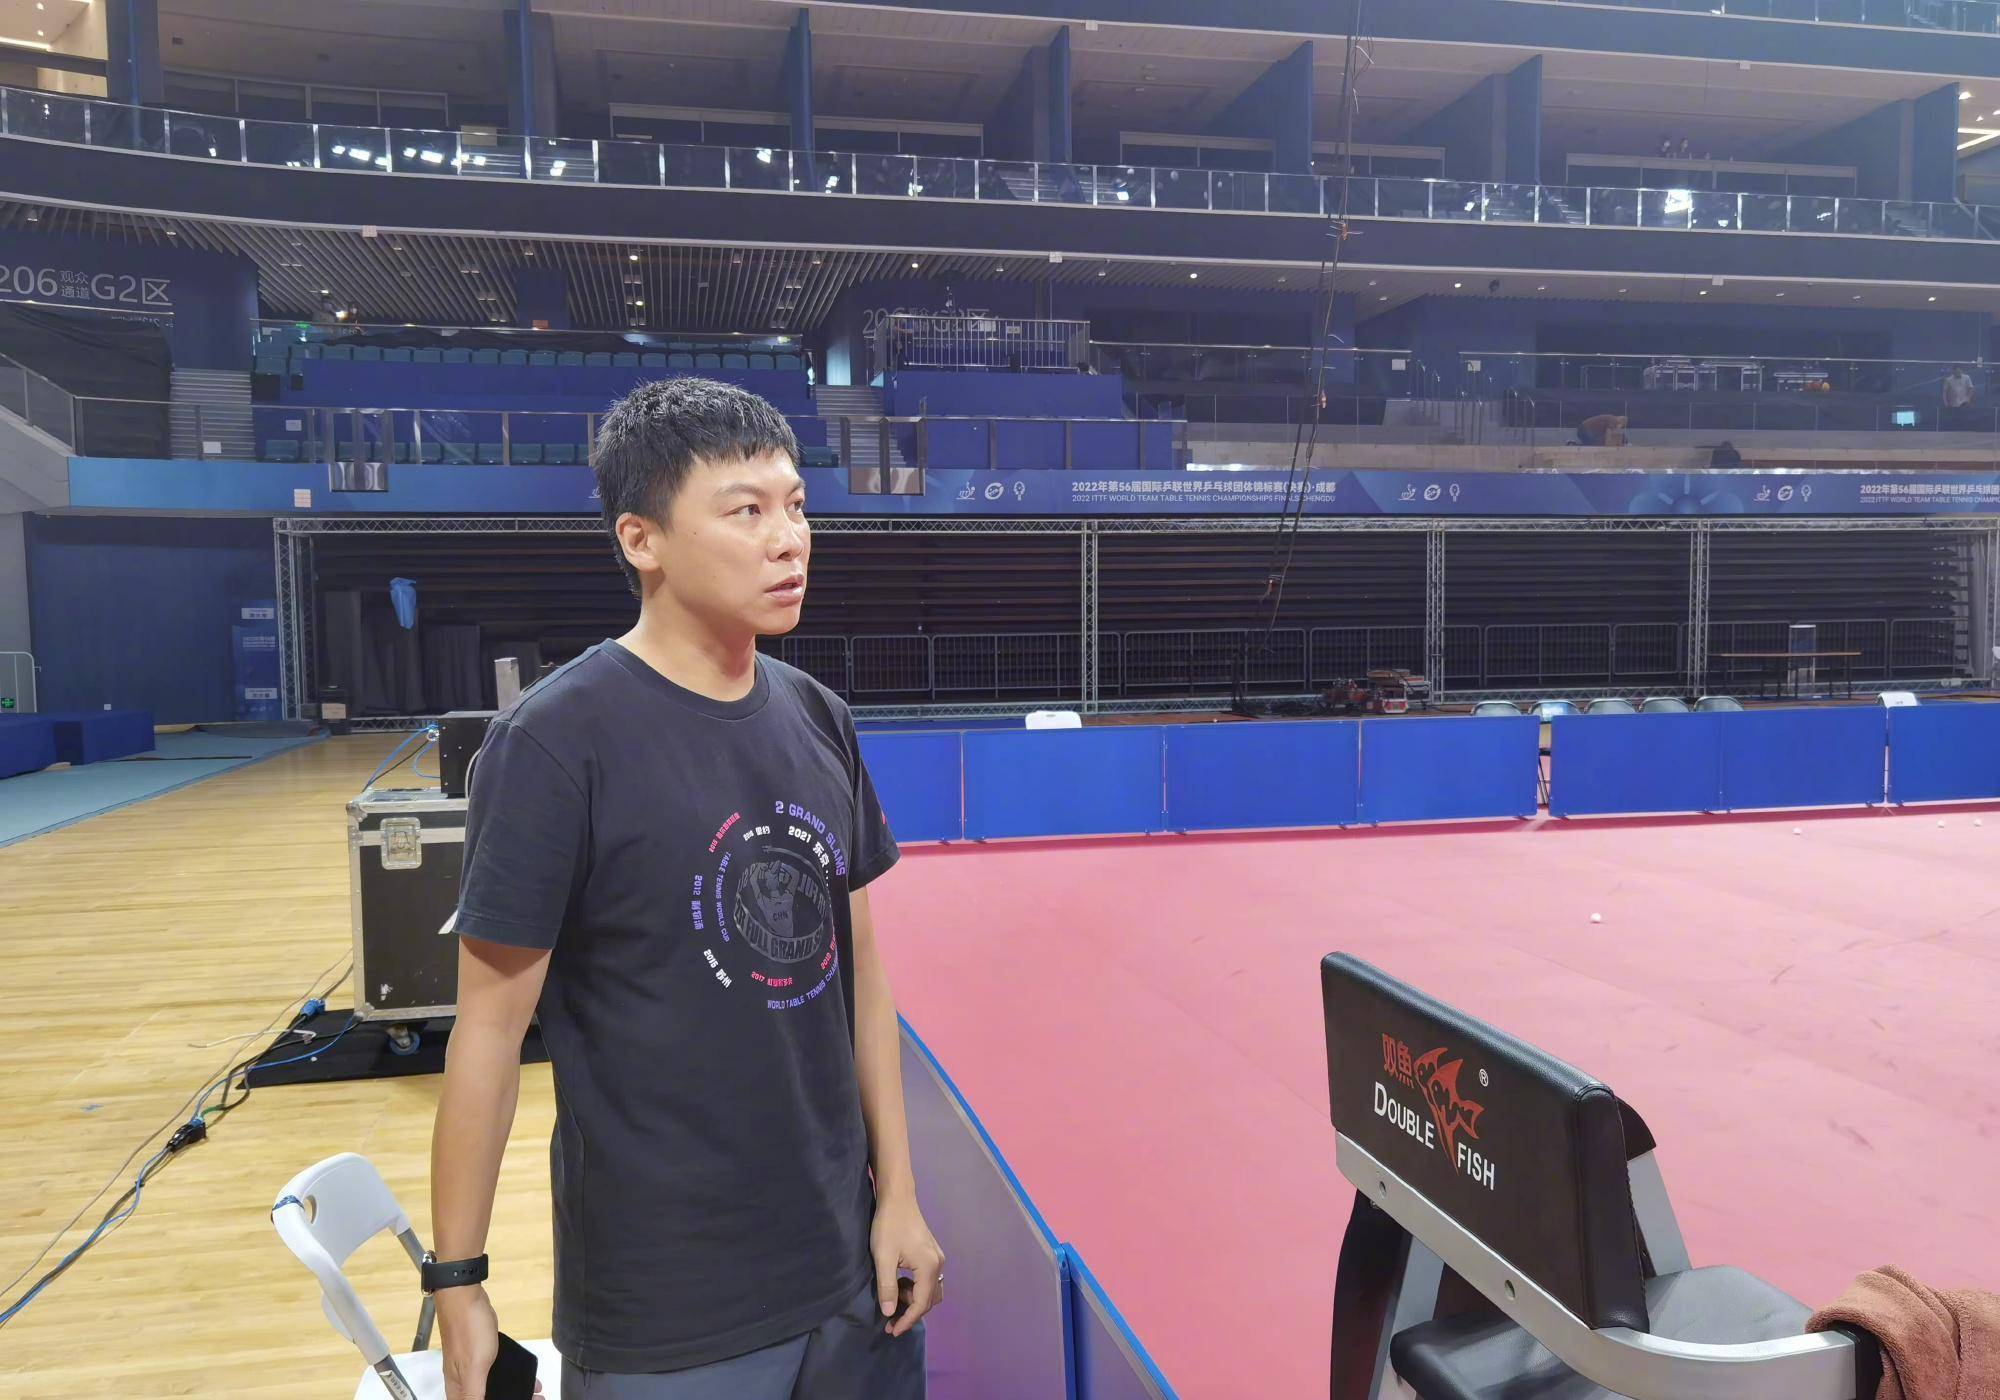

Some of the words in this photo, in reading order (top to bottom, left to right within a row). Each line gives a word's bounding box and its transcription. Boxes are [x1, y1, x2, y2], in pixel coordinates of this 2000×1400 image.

[0, 265, 58, 296] 206
[60, 271, 89, 285] 观众
[91, 273, 173, 306] G2区
[61, 286, 90, 299] 通道
[1072, 494, 1090, 502] 2022
[1092, 494, 1107, 502] ITTF
[1109, 494, 1135, 502] WORLD
[1138, 494, 1158, 502] TEAM
[1160, 494, 1183, 502] TABLE
[1185, 494, 1211, 502] TENNIS
[1213, 494, 1273, 502] CHAMPIONSHIPS
[775, 801, 784, 814] 2
[789, 803, 826, 834] GRAND
[825, 833, 846, 876] SLAMS
[788, 826, 811, 843] 2021
[719, 851, 732, 873] TABLE
[693, 875, 703, 896] 2012
[715, 874, 724, 899] TENNIS
[716, 902, 725, 926] WORLD
[720, 928, 730, 943] CUP
[767, 999, 785, 1010] WORLD
[786, 995, 805, 1008] TABLE
[806, 981, 826, 1000] TENNIS
[1374, 1081, 1435, 1150] DOUBLE
[1457, 1142, 1495, 1191] FISH
